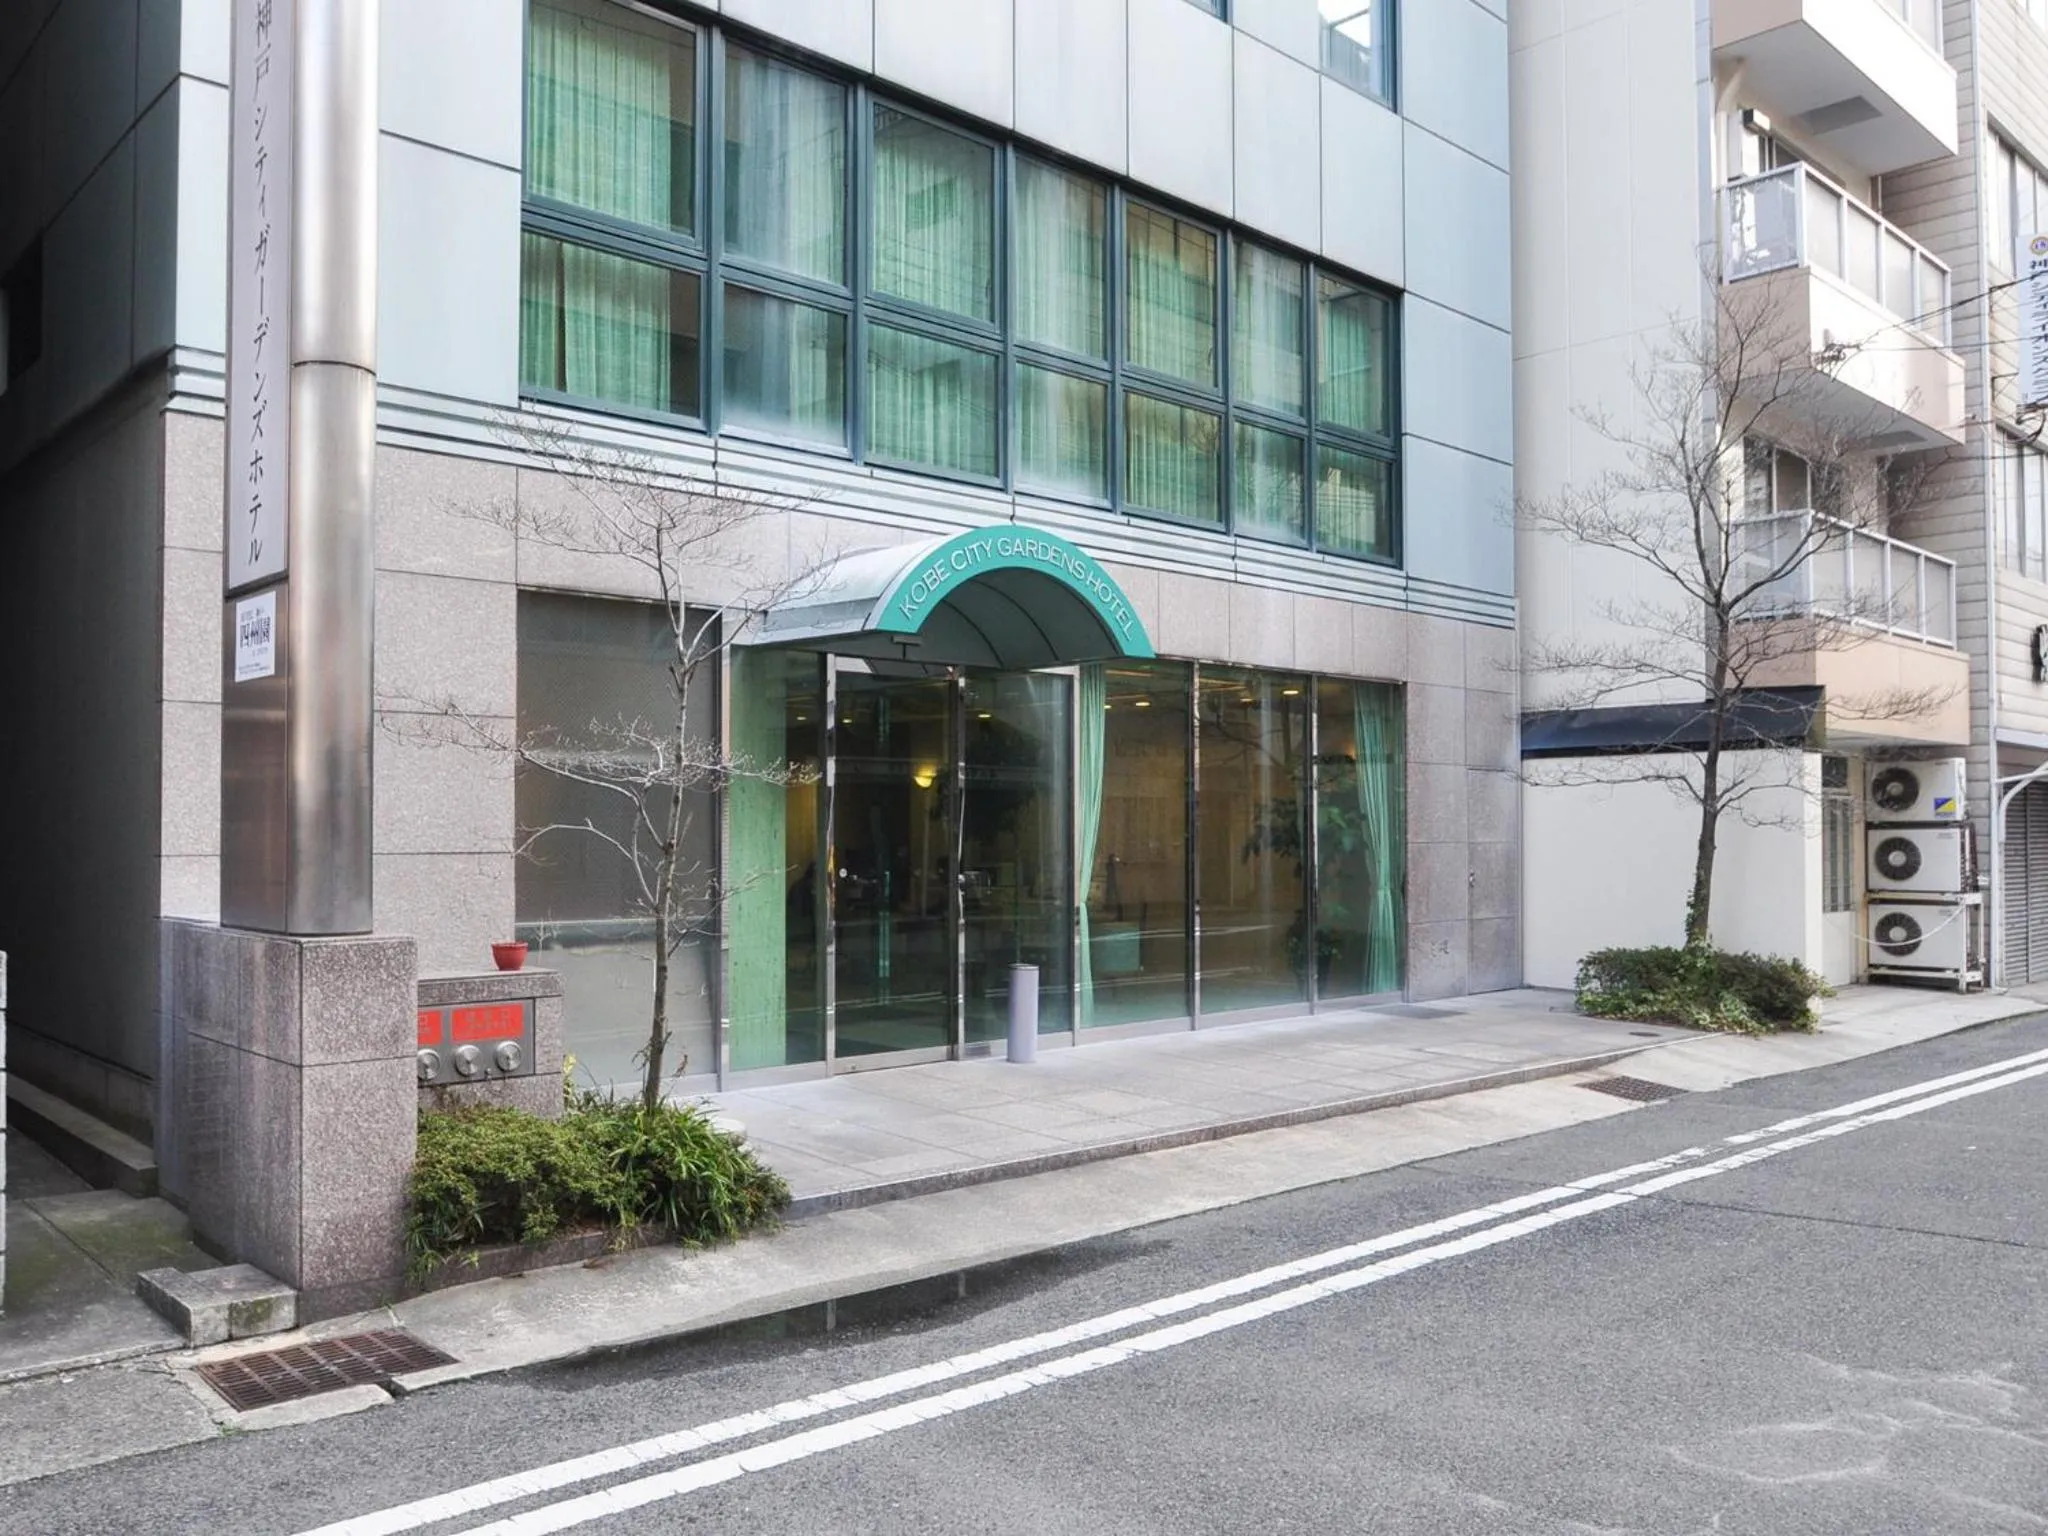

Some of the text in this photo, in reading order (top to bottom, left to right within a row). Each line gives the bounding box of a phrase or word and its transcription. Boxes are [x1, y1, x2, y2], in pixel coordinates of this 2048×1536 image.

[248, 0, 273, 565] 神戸シティガーデンズホテル
[899, 537, 1138, 641] KOBE CITY GARDENS HOTEL
